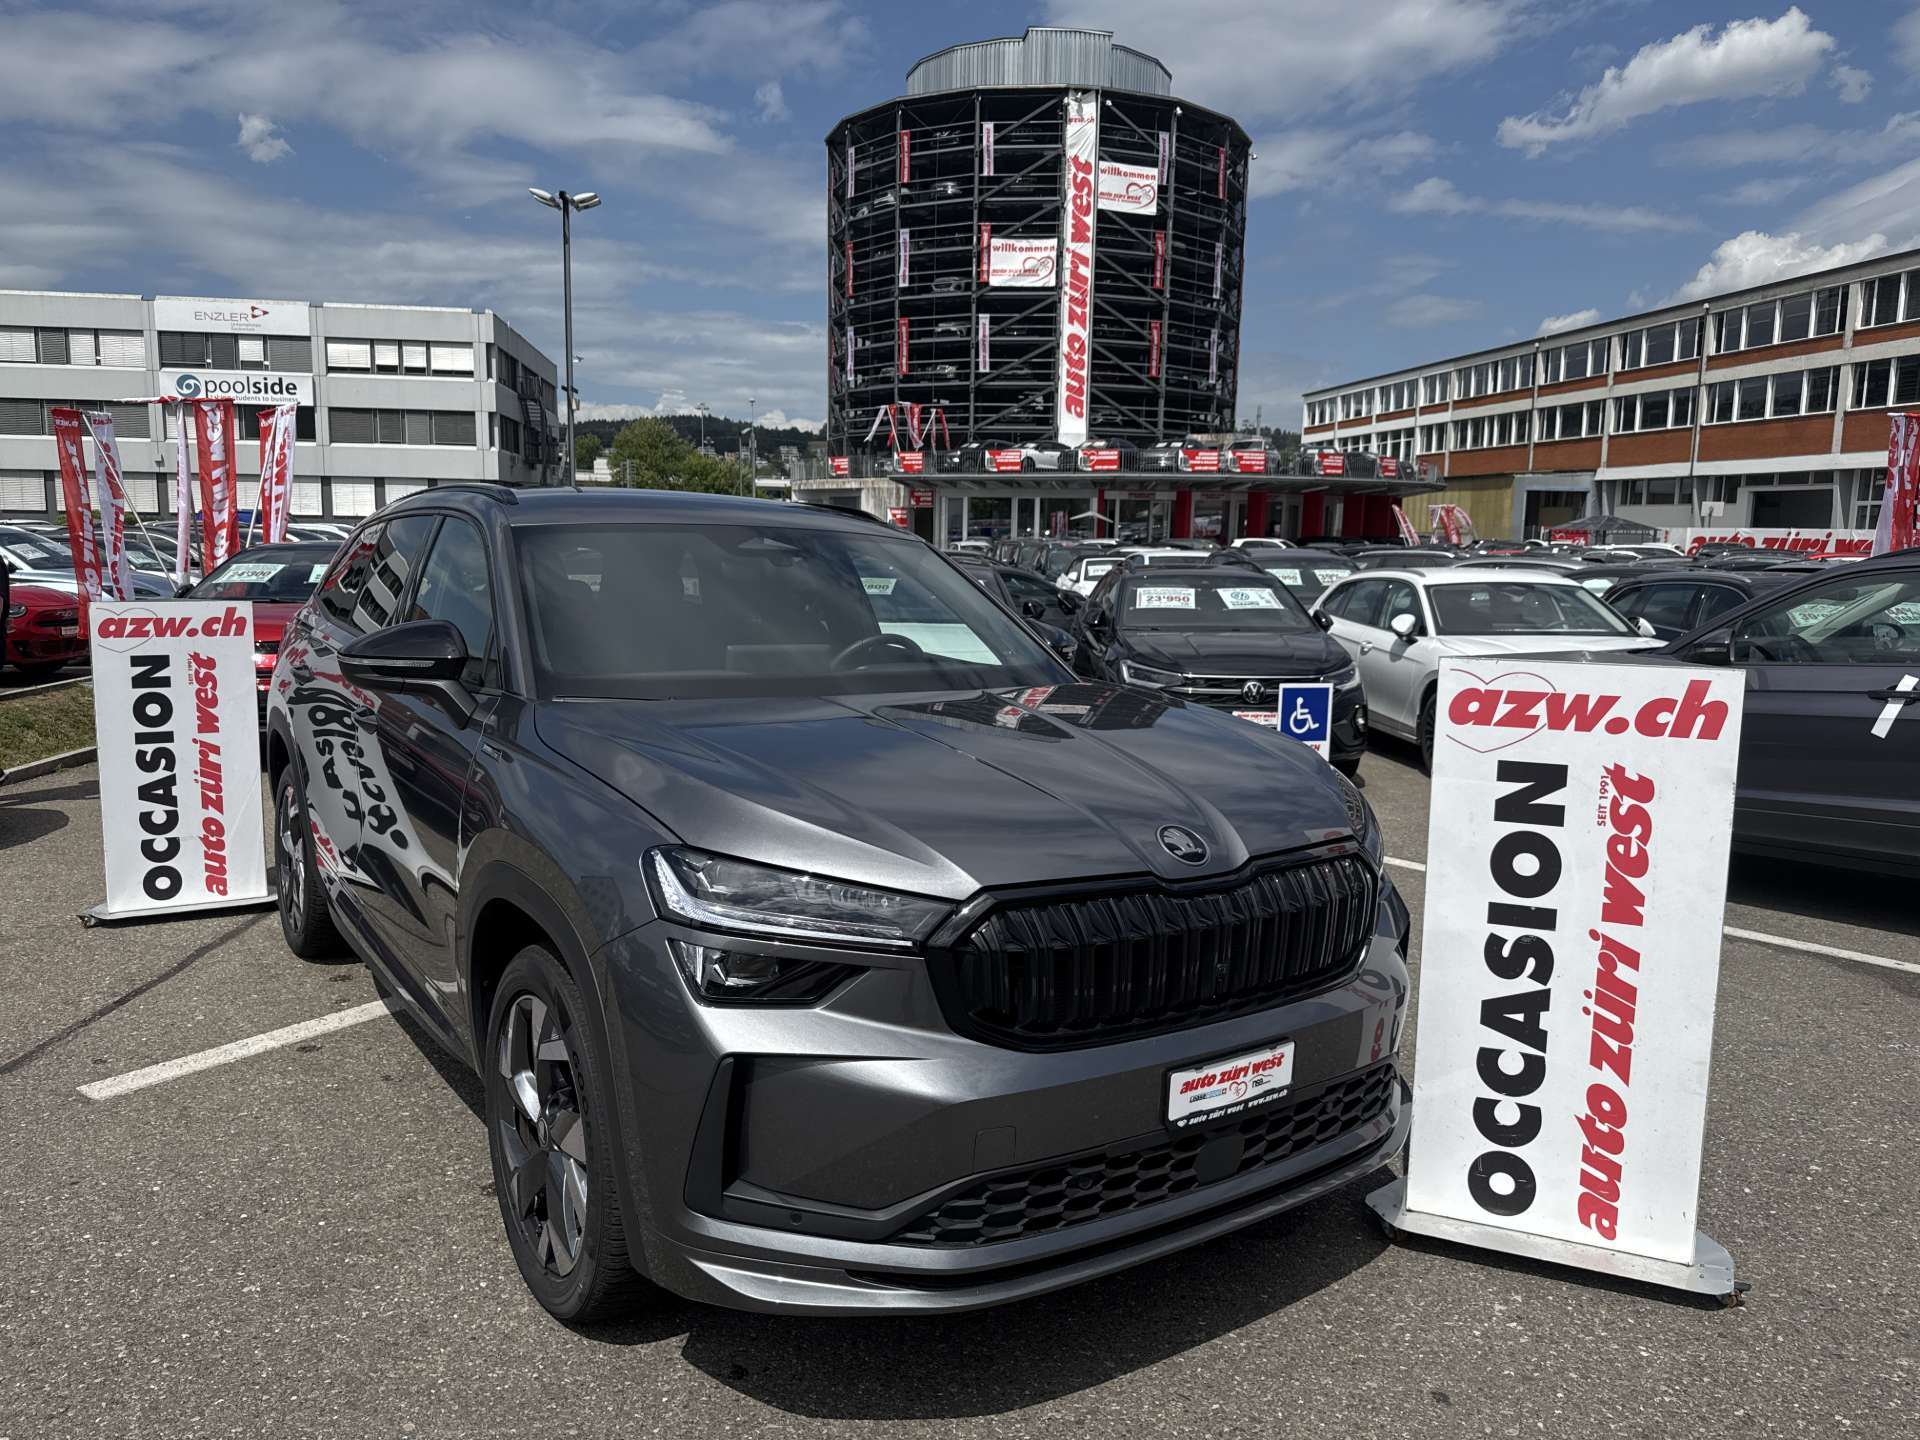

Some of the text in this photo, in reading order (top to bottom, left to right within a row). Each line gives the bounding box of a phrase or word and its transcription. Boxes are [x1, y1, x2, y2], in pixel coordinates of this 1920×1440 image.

[1070, 154, 1093, 243] west
[1100, 166, 1156, 180] willkommen
[992, 243, 1055, 252] willkommen
[194, 311, 249, 322] ENZLER
[205, 376, 298, 398] poolside
[1064, 333, 1087, 419] auto
[98, 607, 248, 639] azw.ch
[1448, 679, 1729, 741] azw.ch
[130, 654, 183, 901] OCCASION
[188, 651, 229, 897] auto züri west
[1597, 774, 1610, 827] SEIT 1991
[1467, 759, 1569, 1217] OCCASION
[1574, 762, 1656, 1241] auto züri west
[1180, 1052, 1285, 1094] auto züri west
[1188, 1114, 1208, 1125] auto
[1208, 1109, 1226, 1120] züri
